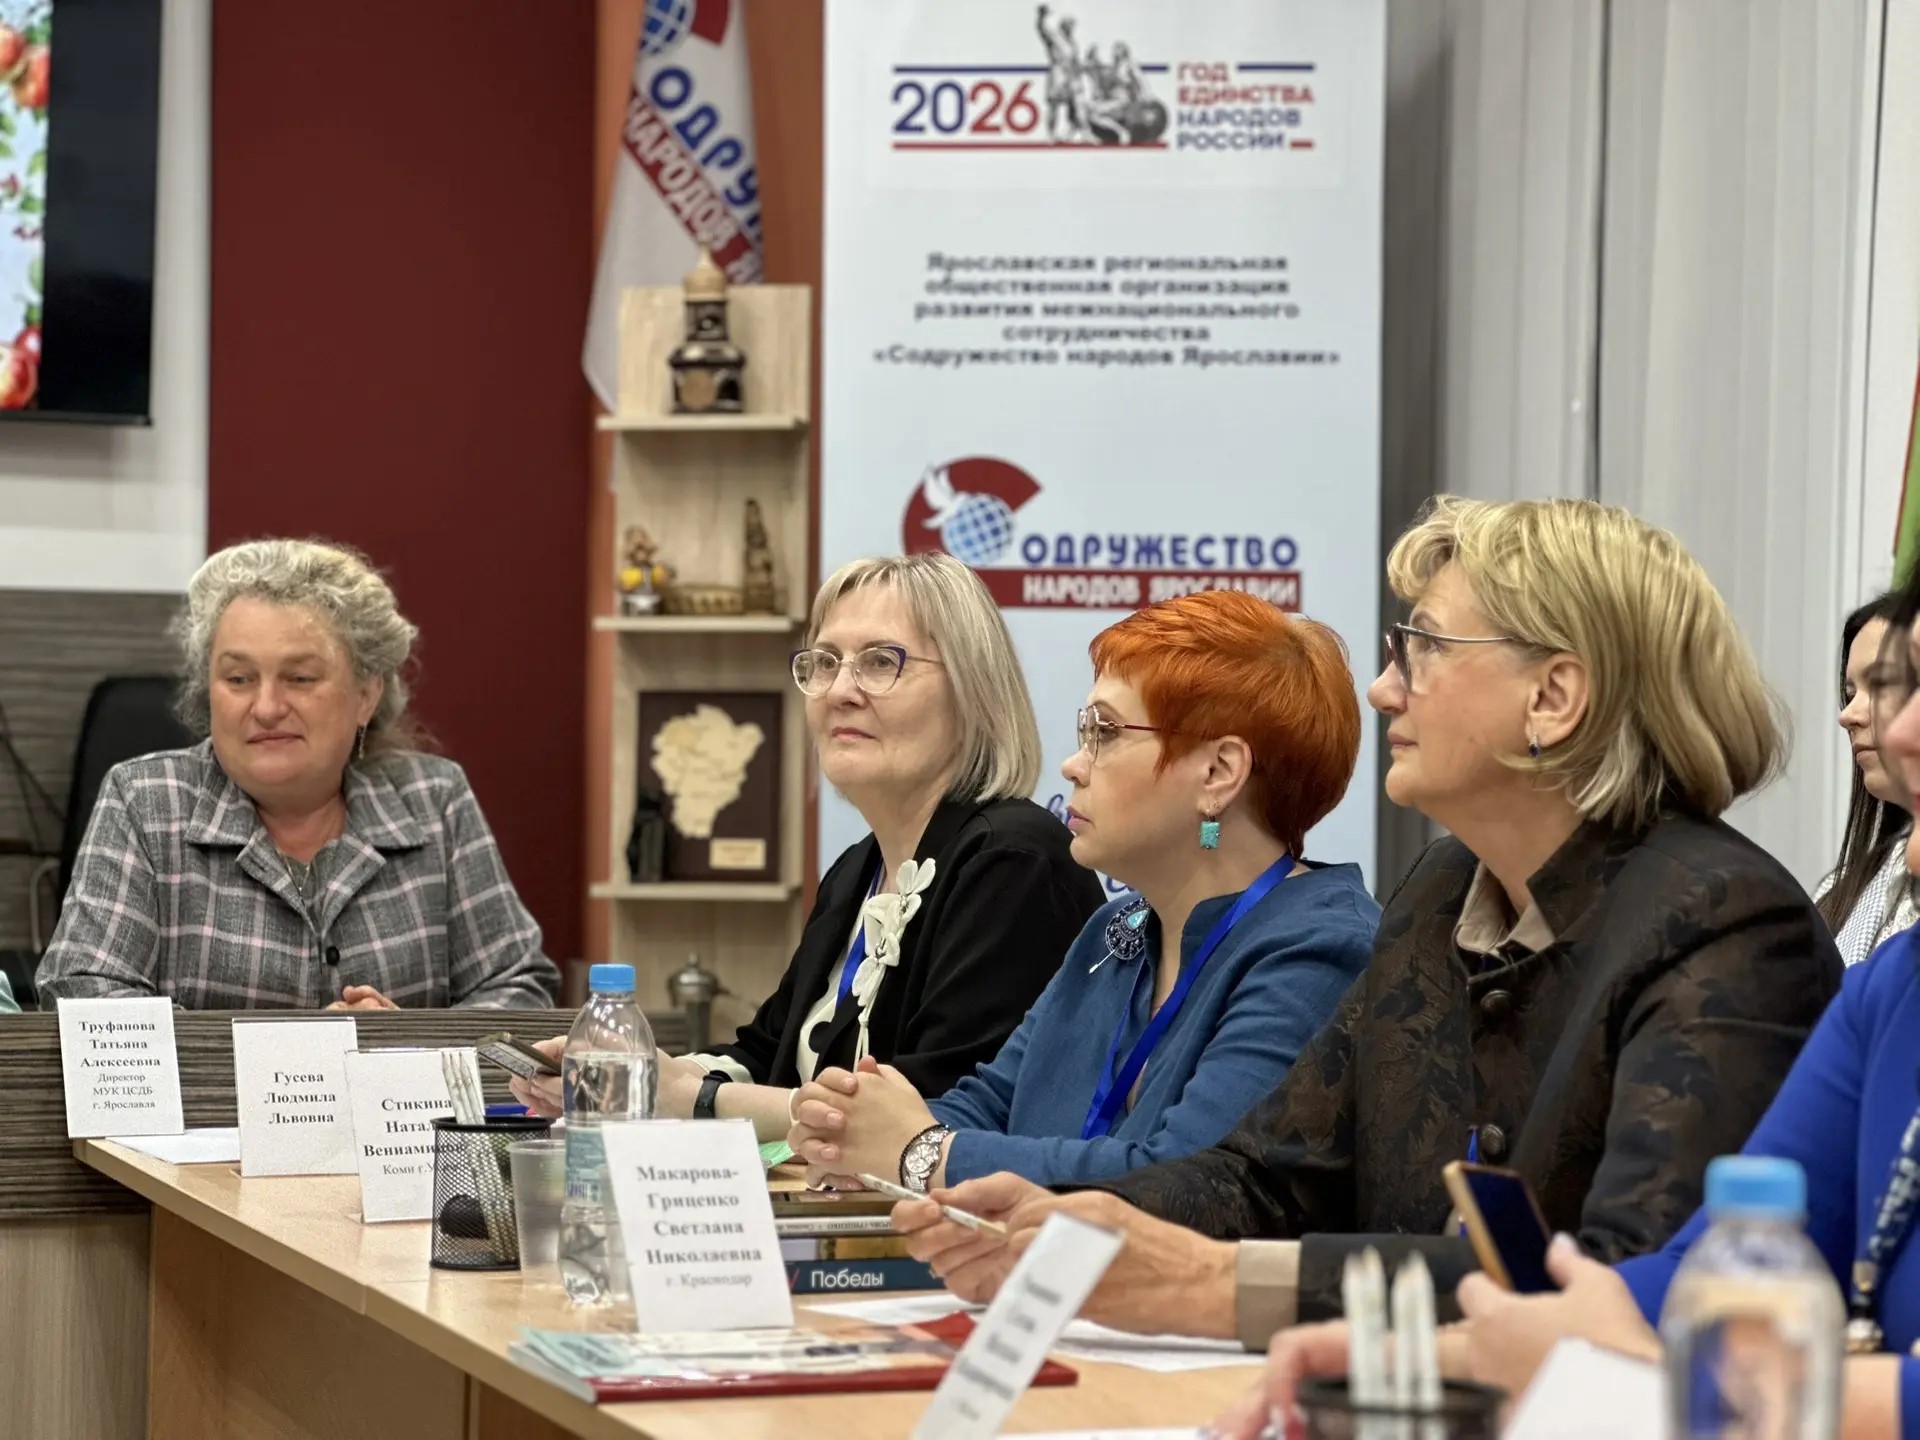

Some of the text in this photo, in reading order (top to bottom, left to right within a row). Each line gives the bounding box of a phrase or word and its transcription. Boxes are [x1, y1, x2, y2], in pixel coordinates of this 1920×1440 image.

[1178, 62, 1229, 82] ГОД
[1178, 85, 1314, 106] ЕДИНСТВА
[893, 80, 1040, 133] 2026
[1177, 108, 1301, 128] НАРОДОВ
[1177, 132, 1284, 150] РОССИИ
[927, 252, 1287, 274] Ярославская региональная
[924, 273, 1289, 298] общественная организация
[914, 303, 1299, 322] развития межнационального
[1002, 326, 1210, 345] сотрудничества
[873, 345, 1340, 369] «Содружество народов Ярославии»
[1022, 575, 1142, 607] НАРОДОВ
[79, 1021, 156, 1034] Труфанова
[89, 1039, 148, 1050] Татьяна
[80, 1057, 161, 1068] Алексеевна
[98, 1073, 146, 1083] Директор
[274, 1072, 325, 1086] Гусева
[93, 1086, 153, 1097] МУК ЦСДБ
[264, 1092, 337, 1105] Людмила
[92, 1100, 156, 1111] г. Ярославля
[381, 1098, 453, 1112] Стикина
[268, 1112, 335, 1125] Львовна
[383, 1164, 415, 1176] Коми
[636, 1166, 740, 1184] Макарова-
[647, 1193, 740, 1211] Гриценко
[653, 1220, 745, 1237] Светлана
[646, 1248, 763, 1265] Николаевна
[680, 1273, 753, 1289] Краснодар
[811, 1269, 885, 1289] Победы
